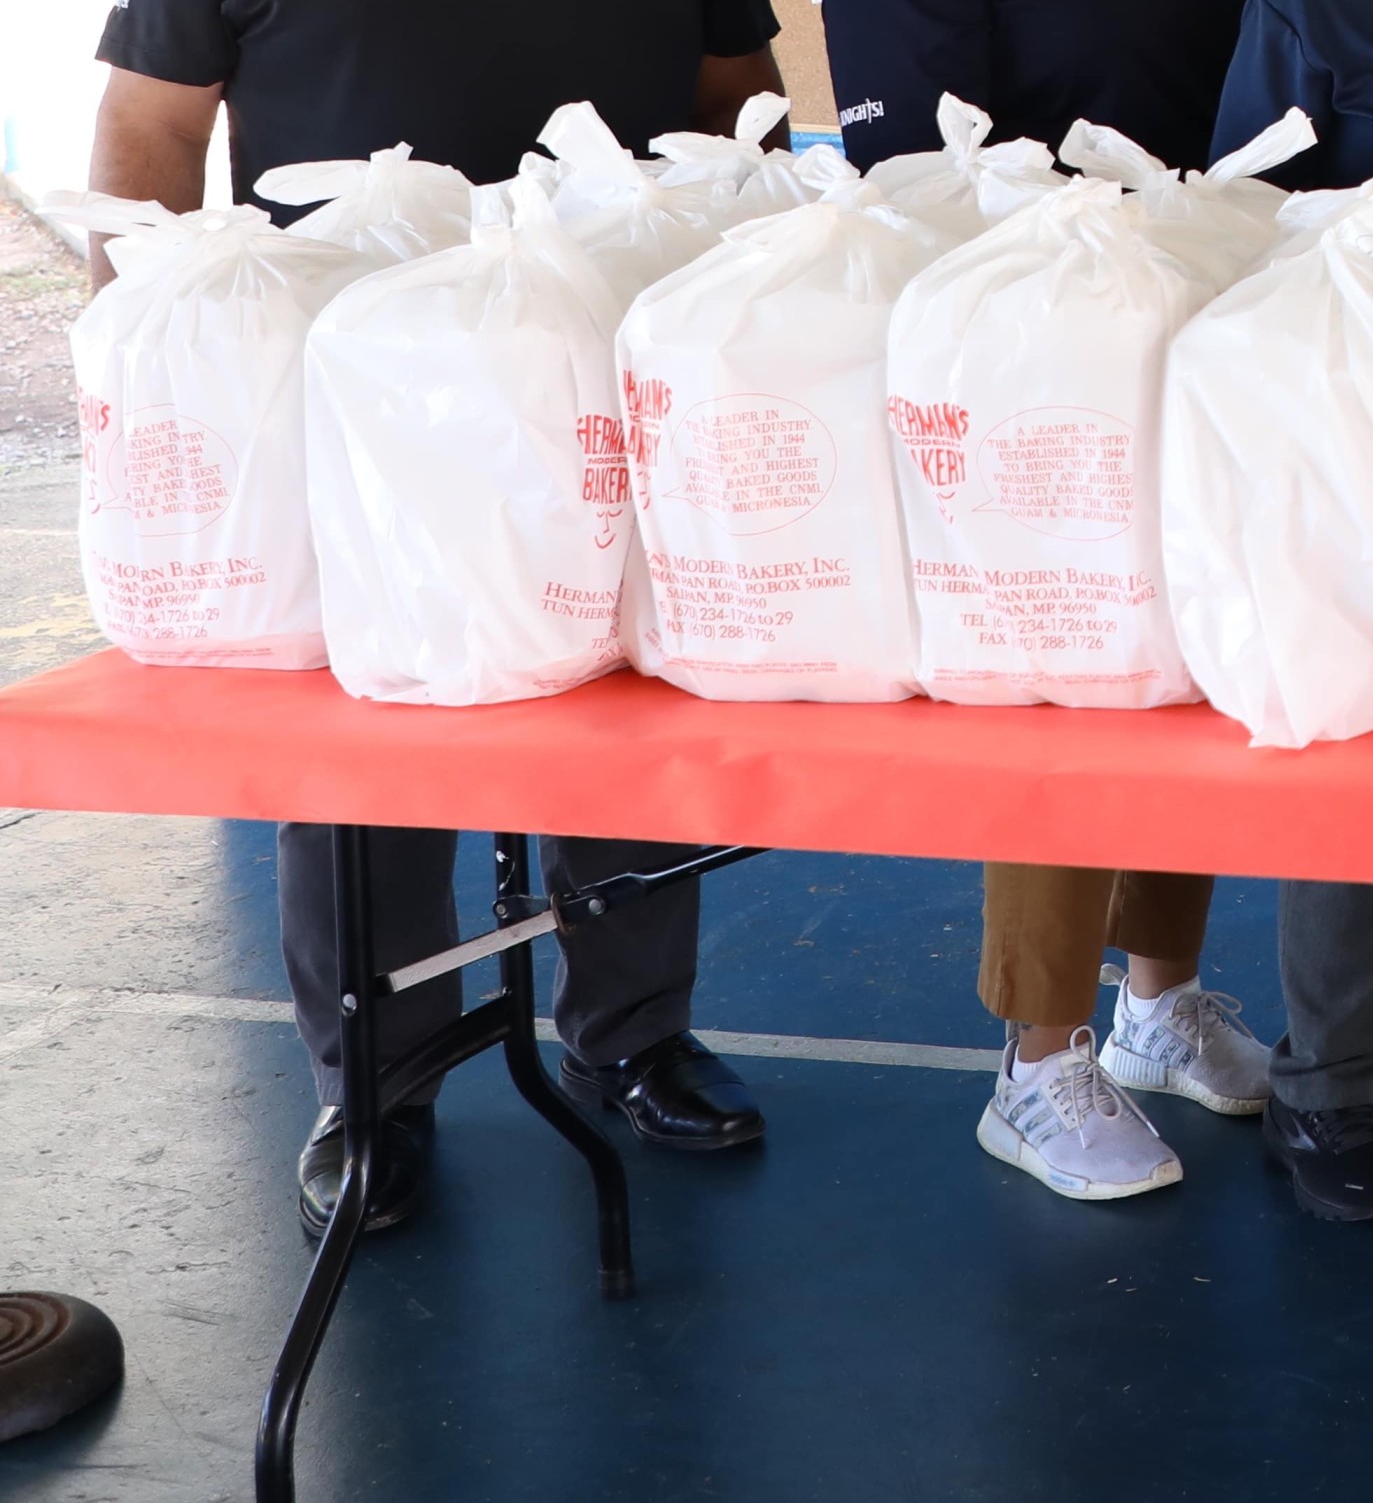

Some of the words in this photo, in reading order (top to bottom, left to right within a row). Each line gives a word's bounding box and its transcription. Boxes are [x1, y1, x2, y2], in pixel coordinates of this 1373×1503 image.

[766, 409, 780, 420] IN
[1018, 427, 1024, 436] A
[1031, 424, 1080, 435] LEADER
[1086, 423, 1098, 433] IN
[763, 435, 776, 446] IN
[783, 433, 805, 444] 1944
[988, 439, 1012, 449] THE
[1018, 437, 1064, 448] BAKING
[745, 449, 770, 460] YOU
[777, 446, 802, 458] THE
[998, 447, 1080, 461] ESTABLISHED
[1085, 448, 1096, 457] IN
[1102, 448, 1126, 459] 1944
[732, 462, 759, 476] AND
[766, 458, 820, 471] HIGHEST
[1004, 463, 1019, 473] TO
[1026, 459, 1064, 472] BRING
[1070, 459, 1091, 470] YOU
[1098, 461, 1122, 472] THE
[727, 474, 771, 489] BAKED
[777, 470, 817, 483] GOODS
[993, 472, 1053, 485] FRESHEST
[1061, 472, 1083, 483] AND
[736, 490, 750, 501] IN
[758, 485, 783, 498] THE
[1000, 485, 1049, 496] QUALITY
[1056, 484, 1093, 496] BAKED
[1000, 496, 1060, 507] AVAILABLE
[1066, 496, 1078, 506] IN
[1082, 497, 1104, 509] THE
[1011, 507, 1043, 518] GUAM
[1049, 508, 1057, 518] &
[737, 561, 808, 580] BAKERY,
[813, 556, 850, 573] INC.
[804, 574, 851, 591] 500002
[984, 569, 1061, 588] MODERN
[541, 599, 575, 616] TUN
[1059, 602, 1097, 614] 96950
[758, 614, 774, 625] to
[776, 611, 794, 626] 29
[960, 614, 988, 627] TEL
[1018, 618, 1084, 633] 234-1726
[1085, 620, 1103, 631] to
[1104, 620, 1118, 634] 29
[979, 632, 1007, 645] FAX
[1040, 636, 1104, 649] 288-1726
